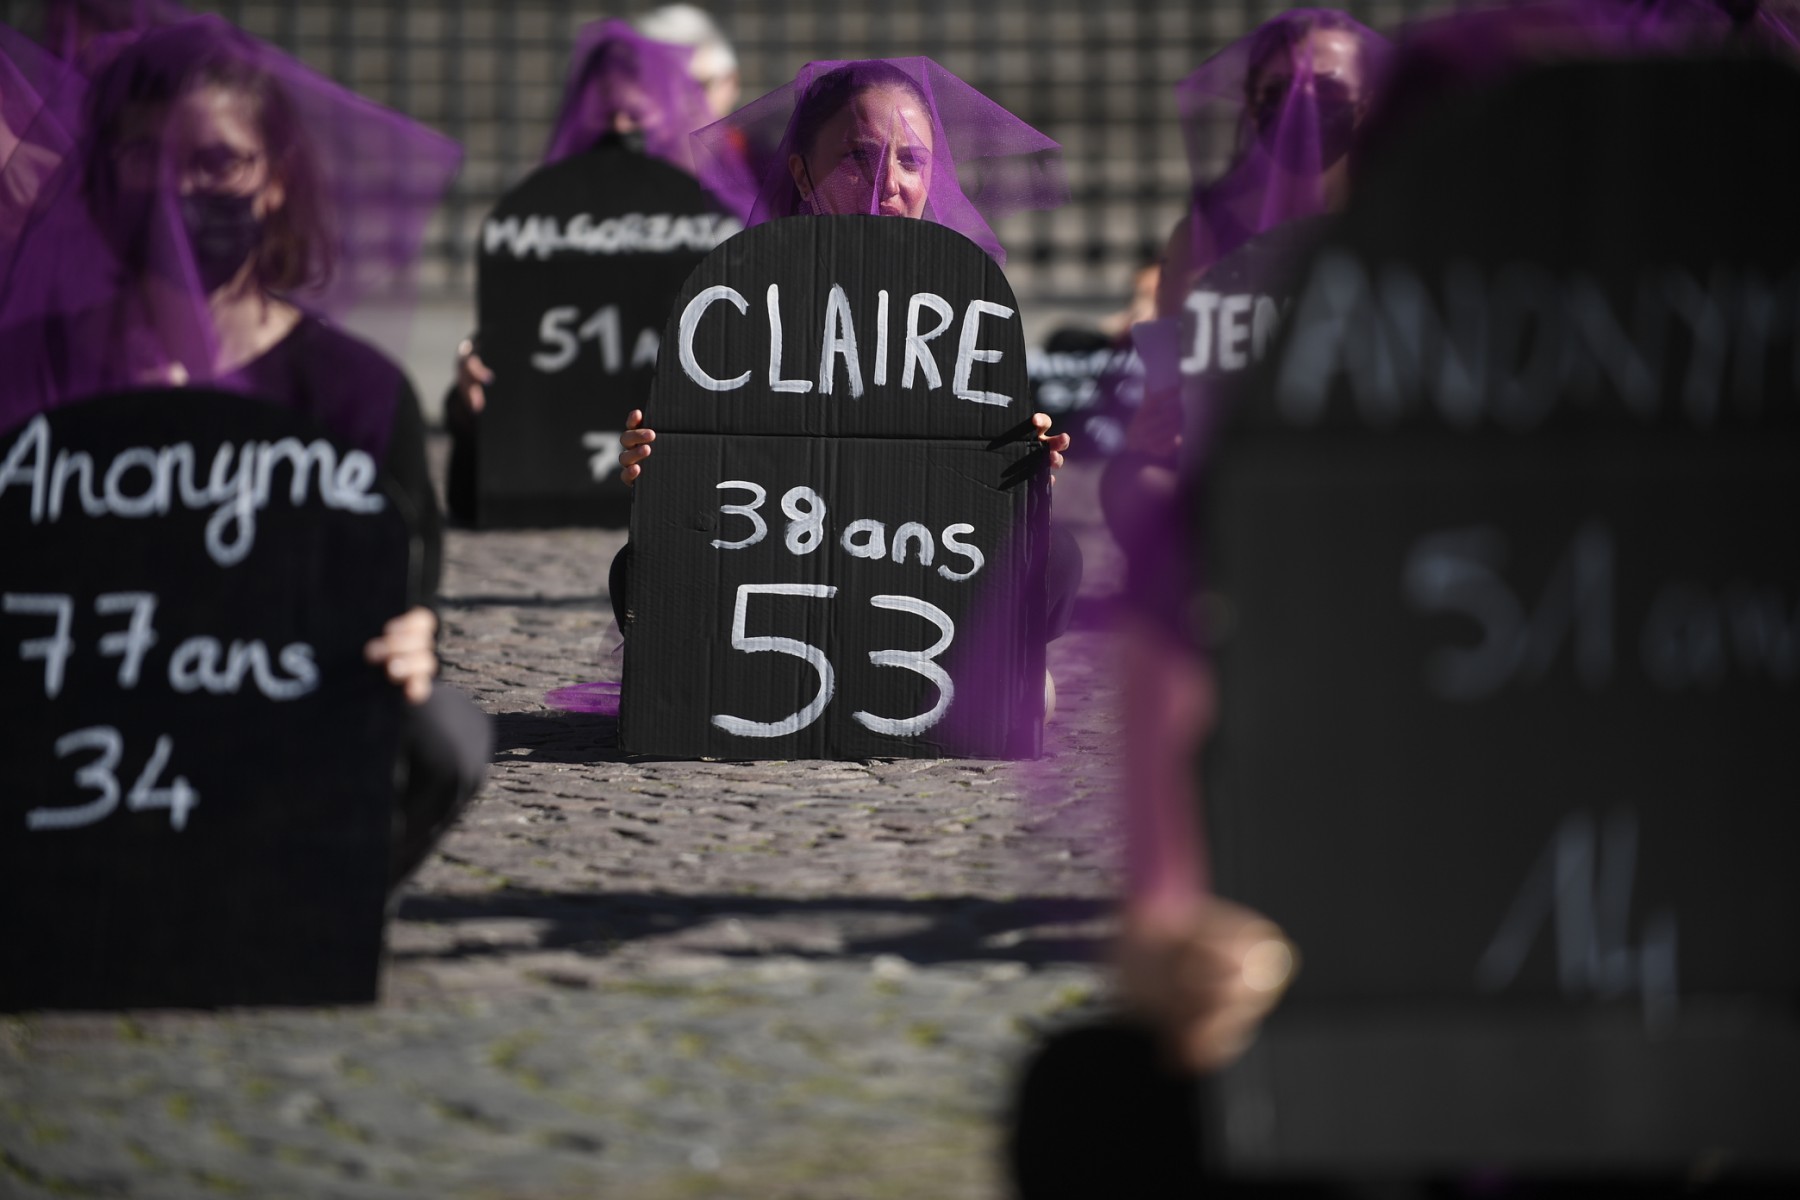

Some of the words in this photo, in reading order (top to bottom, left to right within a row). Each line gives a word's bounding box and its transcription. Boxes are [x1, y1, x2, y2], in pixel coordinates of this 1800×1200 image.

[530, 304, 623, 374] 51
[678, 283, 1014, 407] CLAIRE
[0, 413, 386, 567] Anonyme
[710, 480, 826, 555] 38
[840, 519, 985, 582] ans
[2, 591, 158, 698] 77
[168, 636, 321, 700] ans
[711, 583, 955, 738] 53
[26, 725, 202, 831] 34
